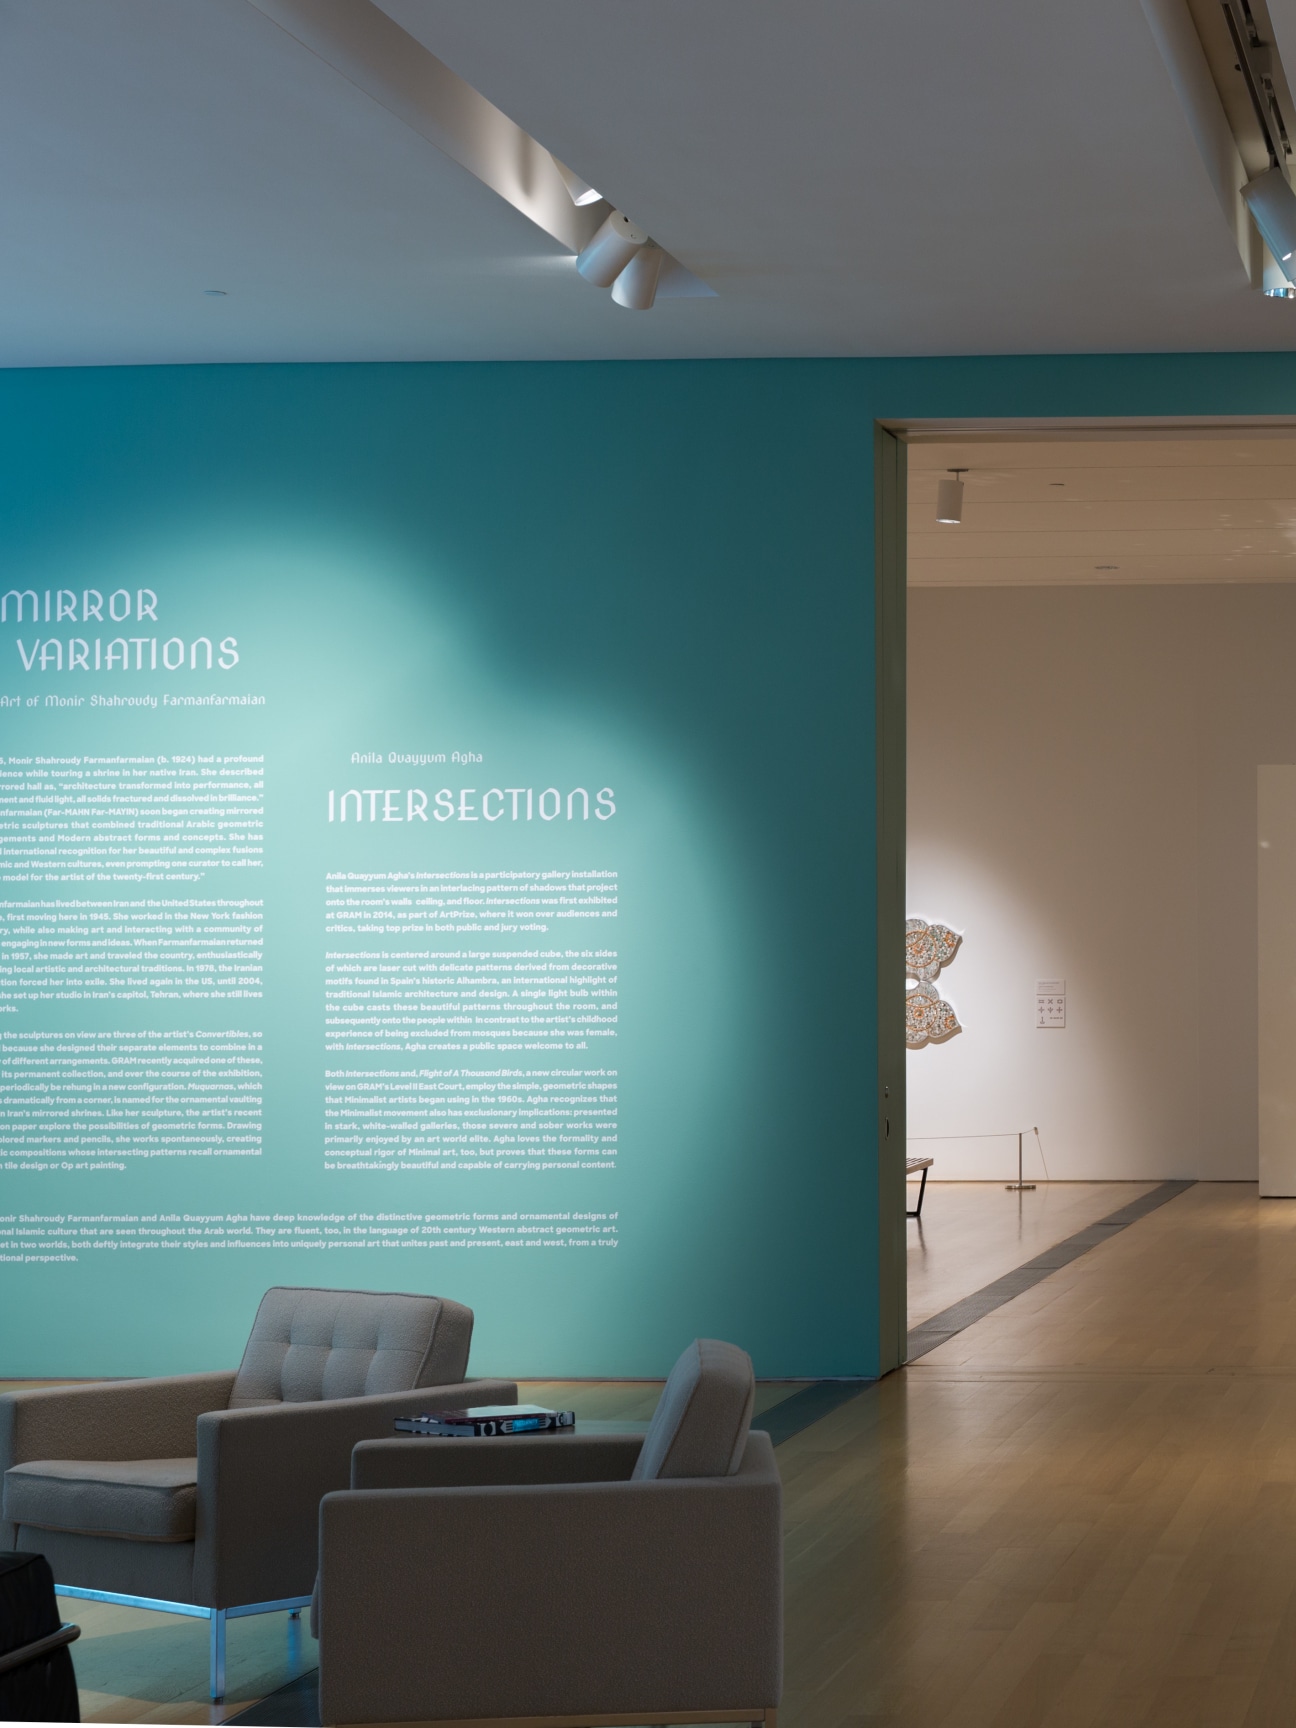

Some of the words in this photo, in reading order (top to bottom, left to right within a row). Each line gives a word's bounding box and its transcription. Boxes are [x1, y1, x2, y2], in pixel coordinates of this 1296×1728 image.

[1, 589, 158, 622] MIRROR
[16, 637, 239, 671] VARIATIONS
[0, 695, 21, 707] Art
[26, 695, 40, 707] of
[45, 694, 85, 707] Monir
[90, 694, 158, 708] Shahroudy
[163, 693, 265, 706] Farmanfarmaian
[35, 756, 82, 765] Shahroudy
[157, 756, 169, 765] (b.
[172, 756, 196, 764] 1924)
[224, 755, 264, 764] profound
[351, 752, 382, 764] Anila
[388, 751, 446, 766] Quayyum
[451, 751, 483, 765] Agha
[328, 787, 617, 822] INTERSECTIONS
[22, 822, 69, 830] sculptures
[218, 820, 264, 829] geometric
[113, 873, 164, 882] twenty-first
[166, 873, 205, 881] century.”
[347, 872, 387, 881] Quayyum
[387, 872, 416, 881] Agha's
[484, 871, 541, 880] participatory
[541, 870, 571, 880] gallery
[440, 884, 486, 893] interlacing
[486, 885, 519, 893] pattern
[586, 883, 618, 892] project
[416, 897, 446, 907] ceiling,
[26, 913, 58, 922] moving
[408, 911, 428, 920] part
[357, 924, 385, 934] taking
[386, 925, 401, 933] top
[402, 924, 424, 933] prize
[456, 923, 482, 932] public
[500, 924, 518, 932] jury
[520, 923, 549, 932] voting.
[405, 1043, 427, 1052] Agha
[469, 1042, 496, 1051] public
[324, 1135, 364, 1144] primarily
[366, 1135, 400, 1144] enjoyed
[401, 1135, 412, 1144] by
[493, 1135, 516, 1144] Agha
[559, 1134, 599, 1143] formality
[20, 1162, 49, 1171] design
[61, 1162, 74, 1170] Op
[90, 1161, 126, 1170] painting.
[19, 1214, 66, 1224] Shahroudy
[183, 1214, 224, 1223] Quayyum
[226, 1214, 248, 1223] Agha
[273, 1213, 295, 1222] deep
[297, 1214, 346, 1223] knowledge
[425, 1213, 471, 1222] geometric
[572, 1212, 607, 1221] designs
